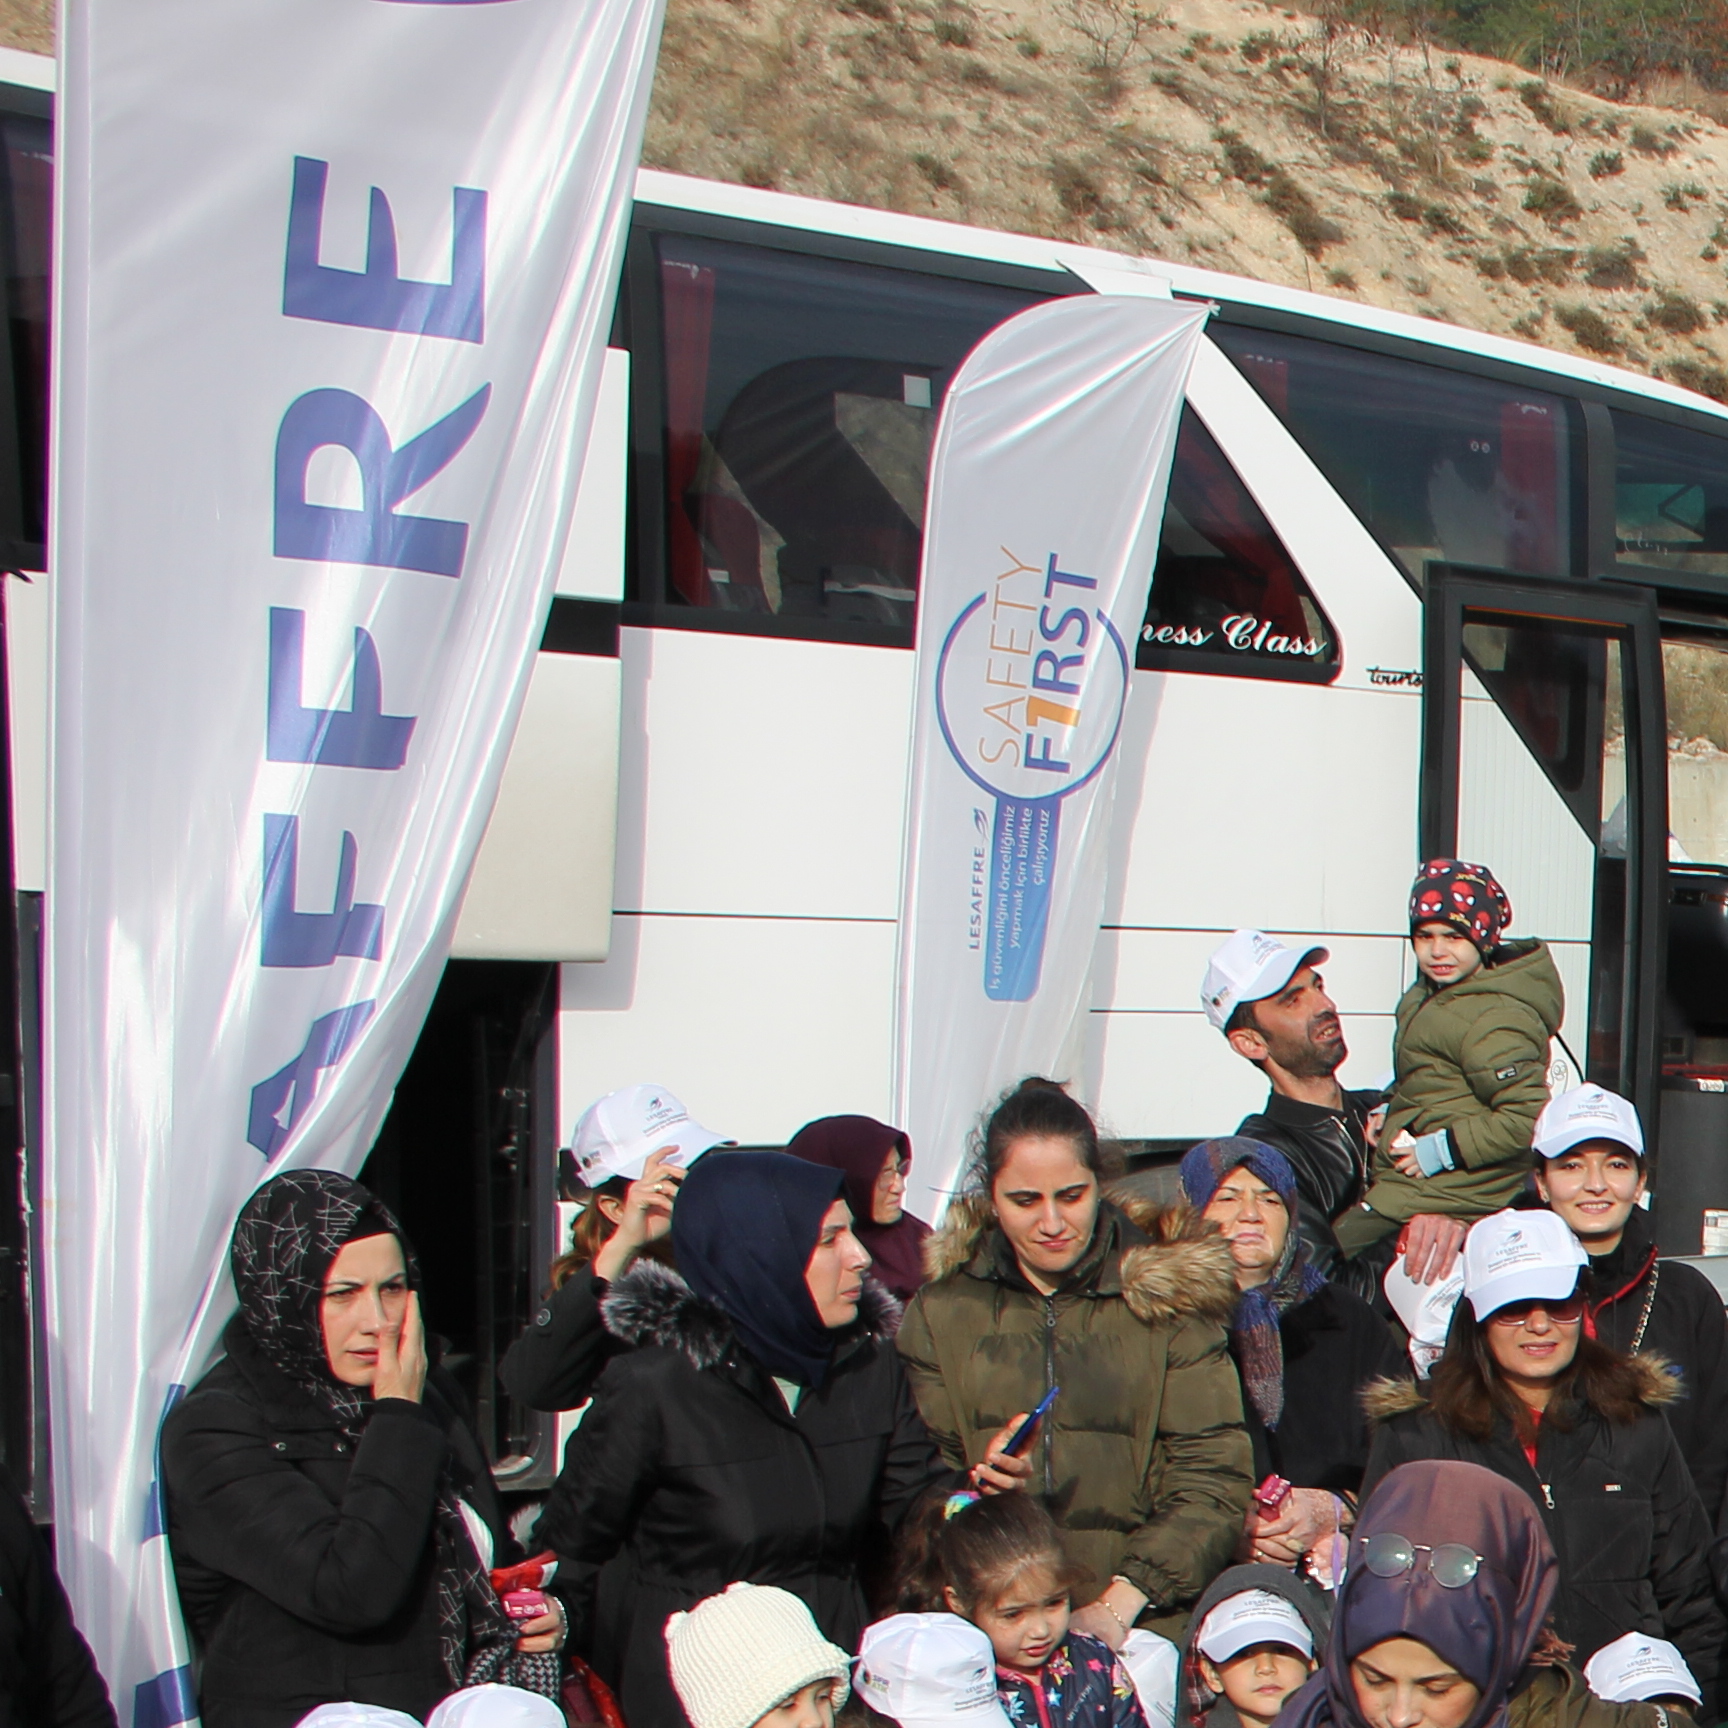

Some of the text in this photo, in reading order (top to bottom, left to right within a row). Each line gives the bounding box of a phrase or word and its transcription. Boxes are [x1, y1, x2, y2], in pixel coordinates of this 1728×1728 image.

[979, 545, 1042, 767] SAFETY
[1222, 613, 1327, 655] Class
[969, 847, 985, 950] LESAFFRE
[1010, 889, 1024, 949] yapmak
[1017, 807, 1033, 858] birlikte
